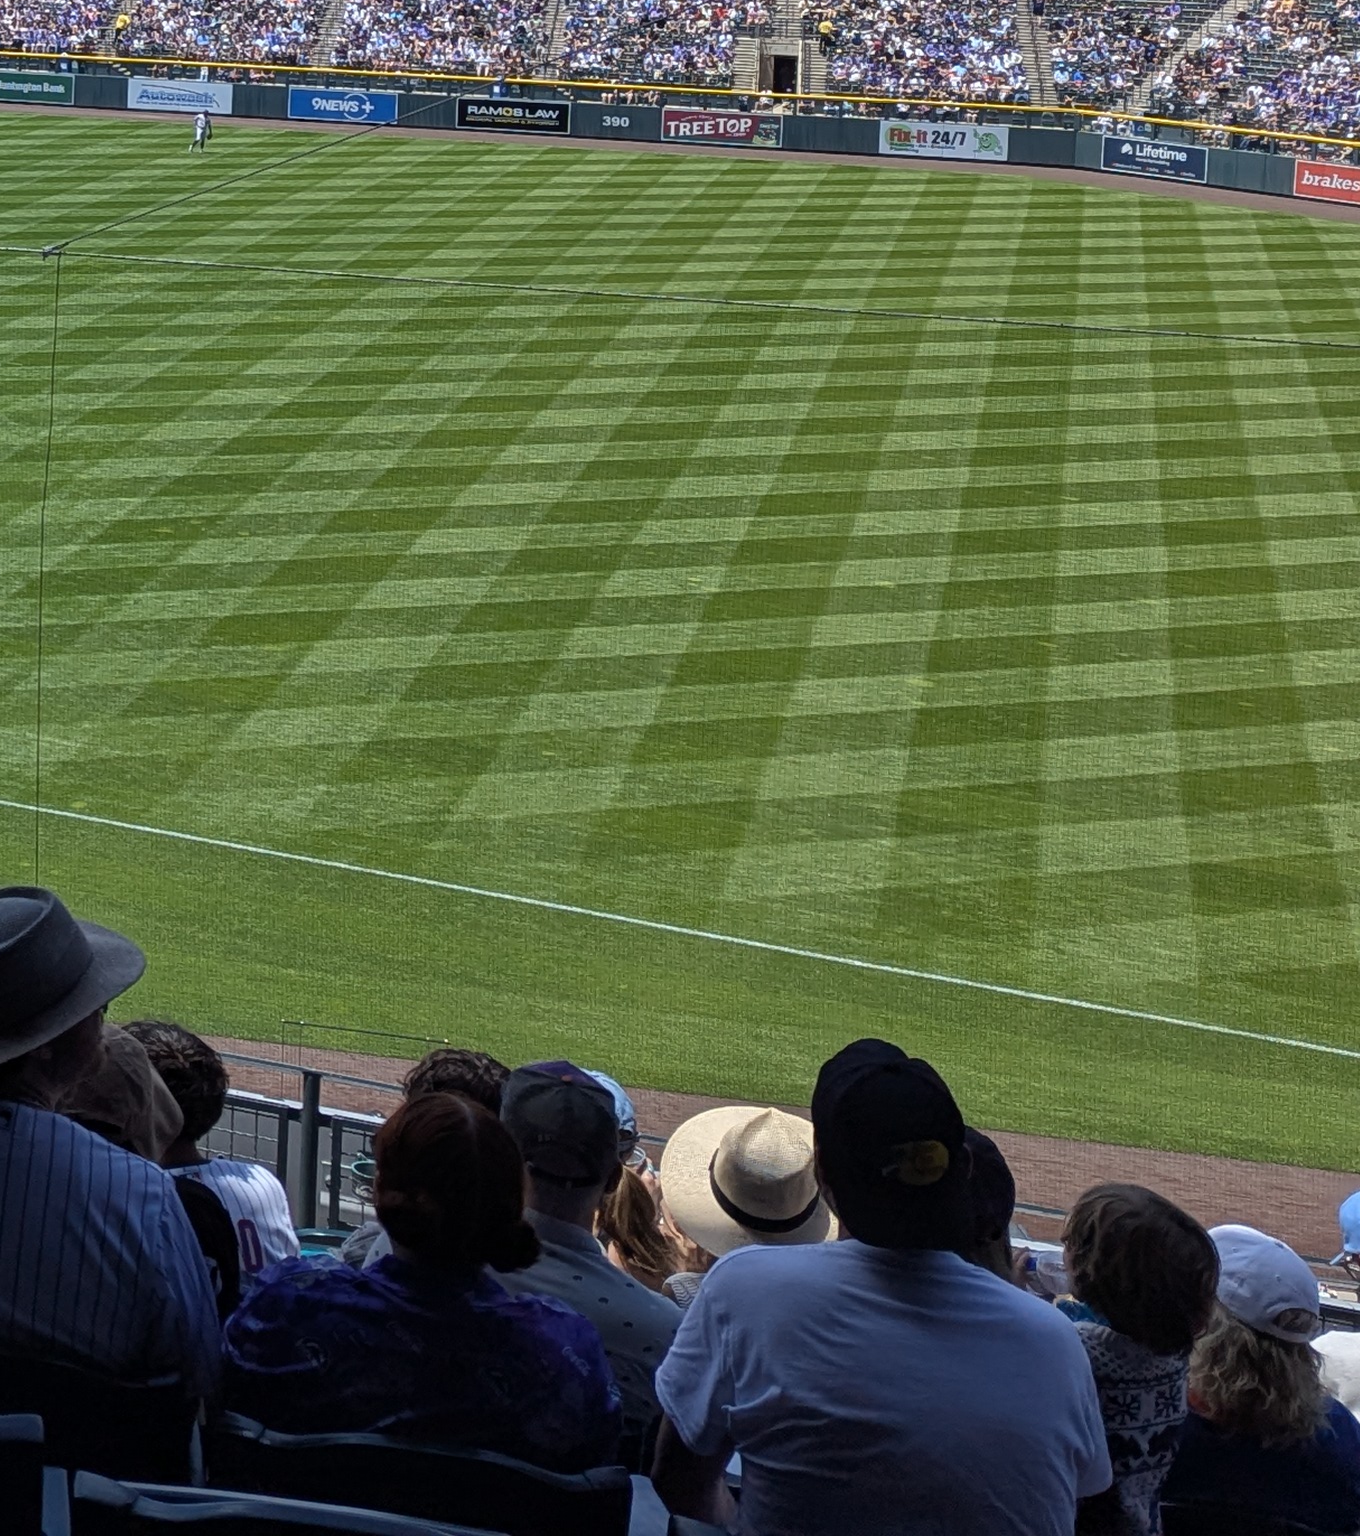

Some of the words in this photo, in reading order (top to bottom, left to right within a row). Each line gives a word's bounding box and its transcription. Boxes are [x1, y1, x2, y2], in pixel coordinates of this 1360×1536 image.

[43, 81, 66, 94] Bank
[137, 89, 214, 104] Autowash
[467, 105, 522, 119] RAMOS
[524, 108, 559, 120] LAW
[602, 116, 630, 127] 390
[667, 120, 716, 137] TREE
[716, 117, 752, 134] TOP
[888, 127, 929, 144] Fix-it
[930, 130, 966, 146] 24/7
[1135, 144, 1188, 162] Lifetime
